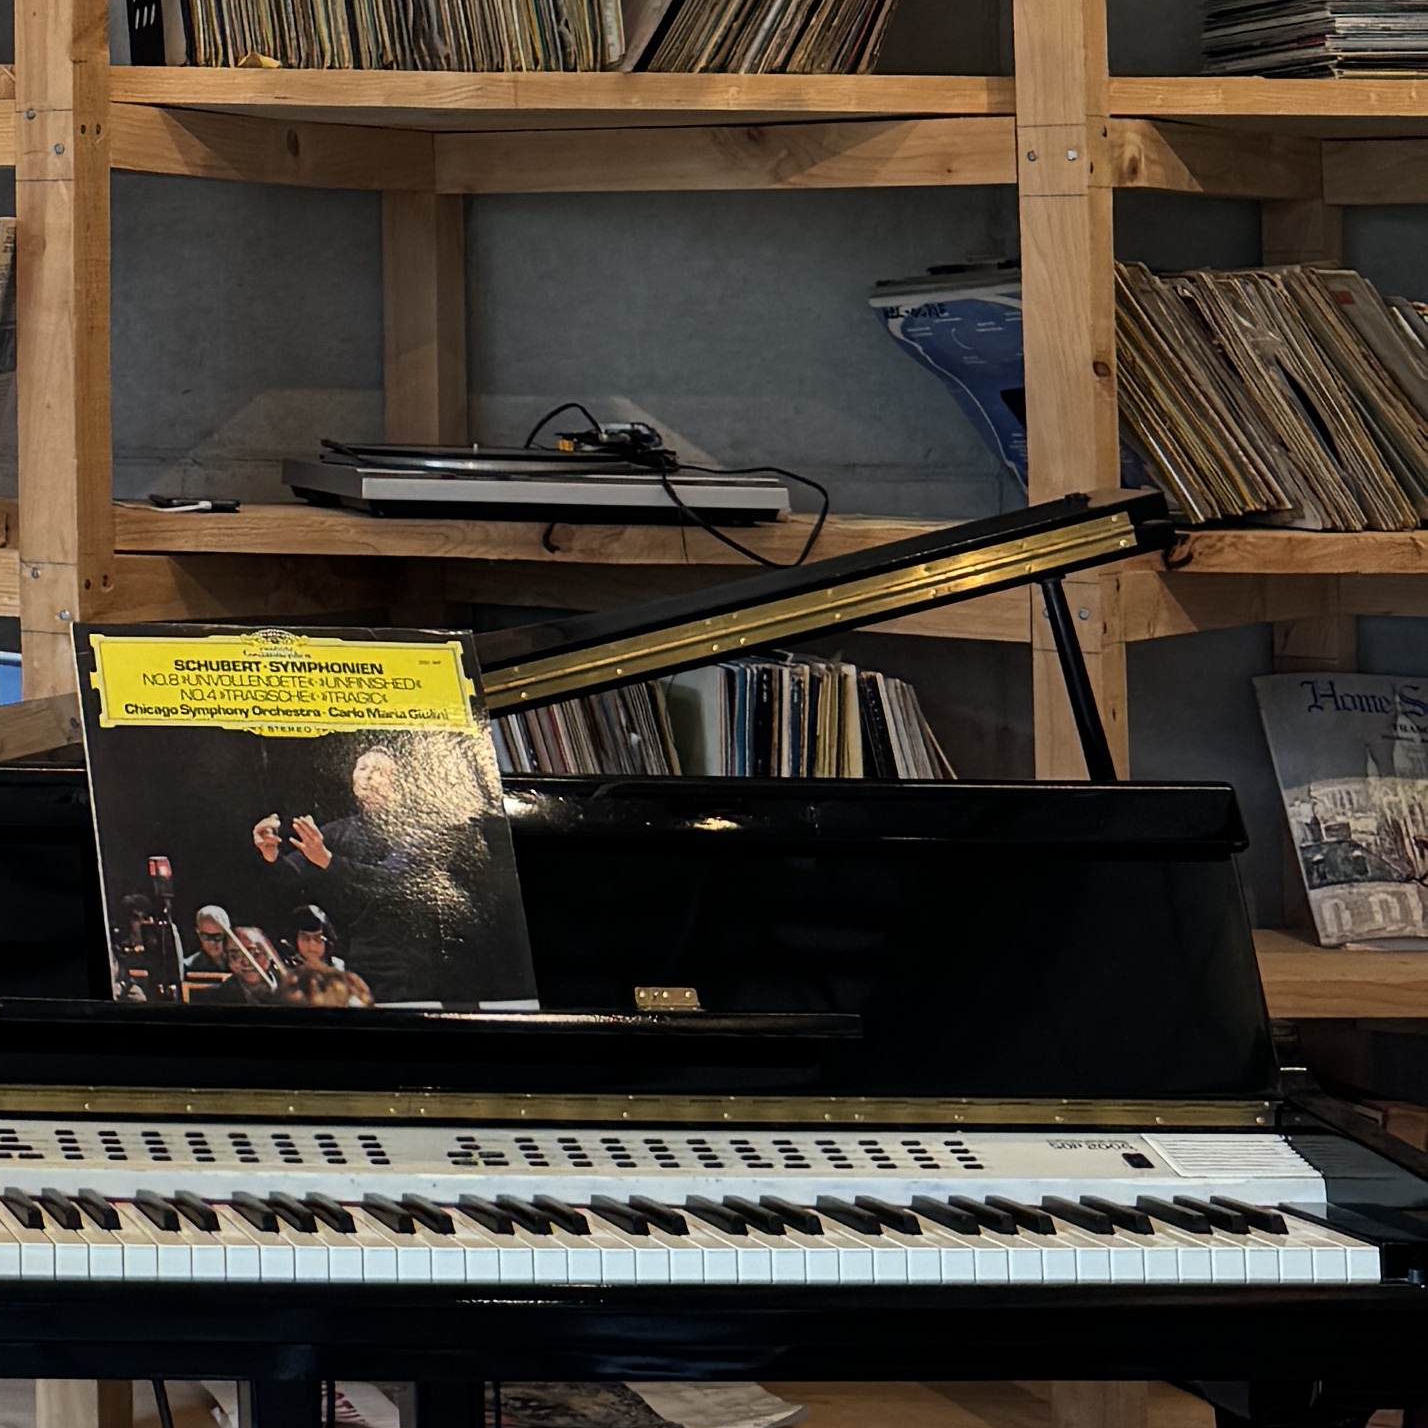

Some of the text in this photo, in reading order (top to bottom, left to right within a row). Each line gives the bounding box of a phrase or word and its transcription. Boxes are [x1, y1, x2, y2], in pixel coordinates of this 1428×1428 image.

[174, 659, 383, 675] SCHUBERT SYMPHONIEN
[1300, 680, 1391, 714] Home
[125, 703, 179, 718] Chicago
[180, 704, 249, 719] Symphony
[252, 705, 321, 718] Orchestra
[328, 707, 364, 719] Carlo
[367, 708, 408, 719] Maria
